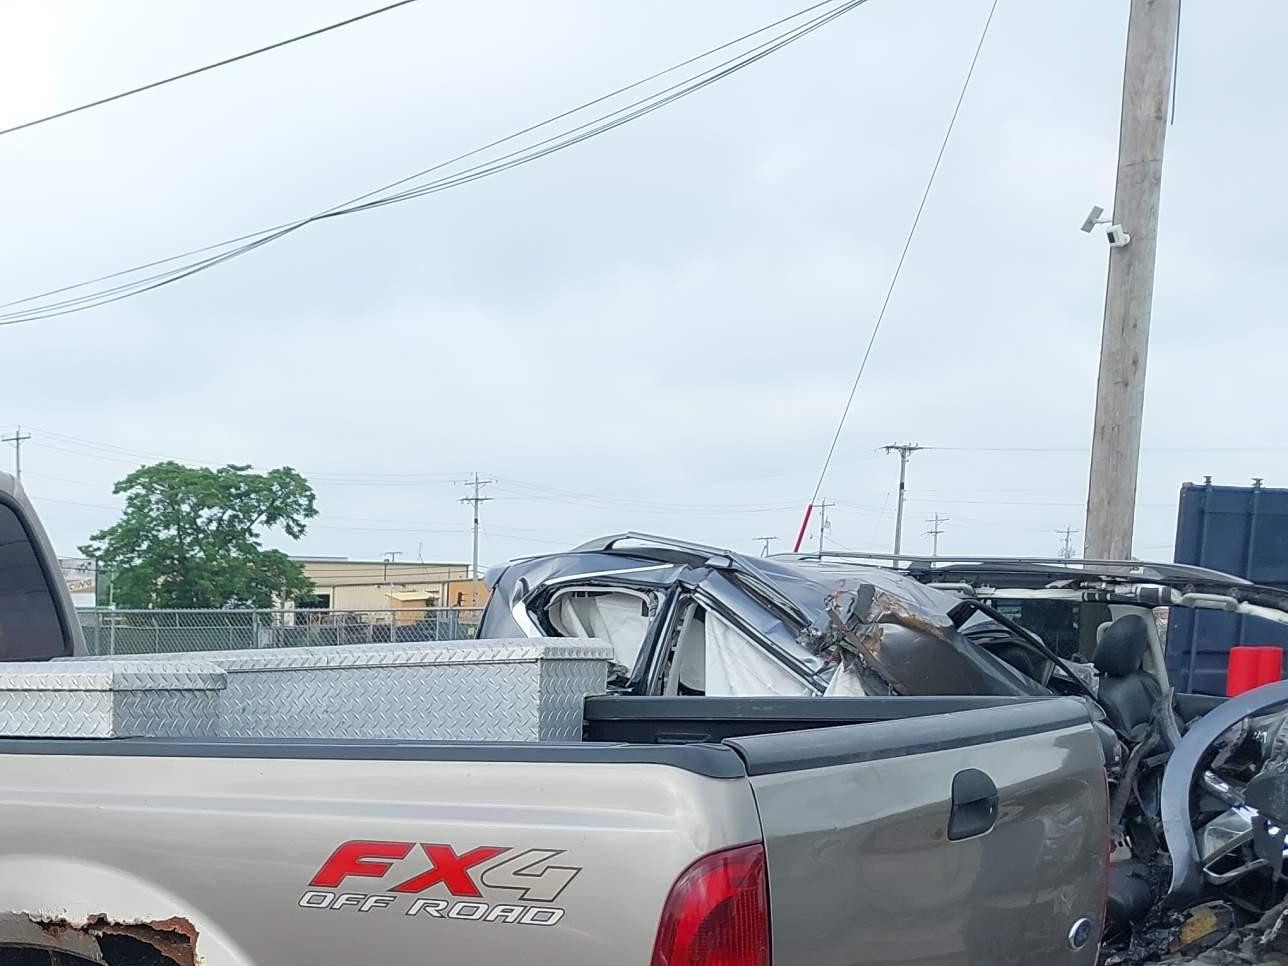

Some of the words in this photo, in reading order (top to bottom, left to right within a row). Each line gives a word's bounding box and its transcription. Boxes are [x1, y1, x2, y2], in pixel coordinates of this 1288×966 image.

[308, 839, 583, 903] FX4
[298, 890, 397, 913] OFF
[406, 898, 566, 927] ROAD
